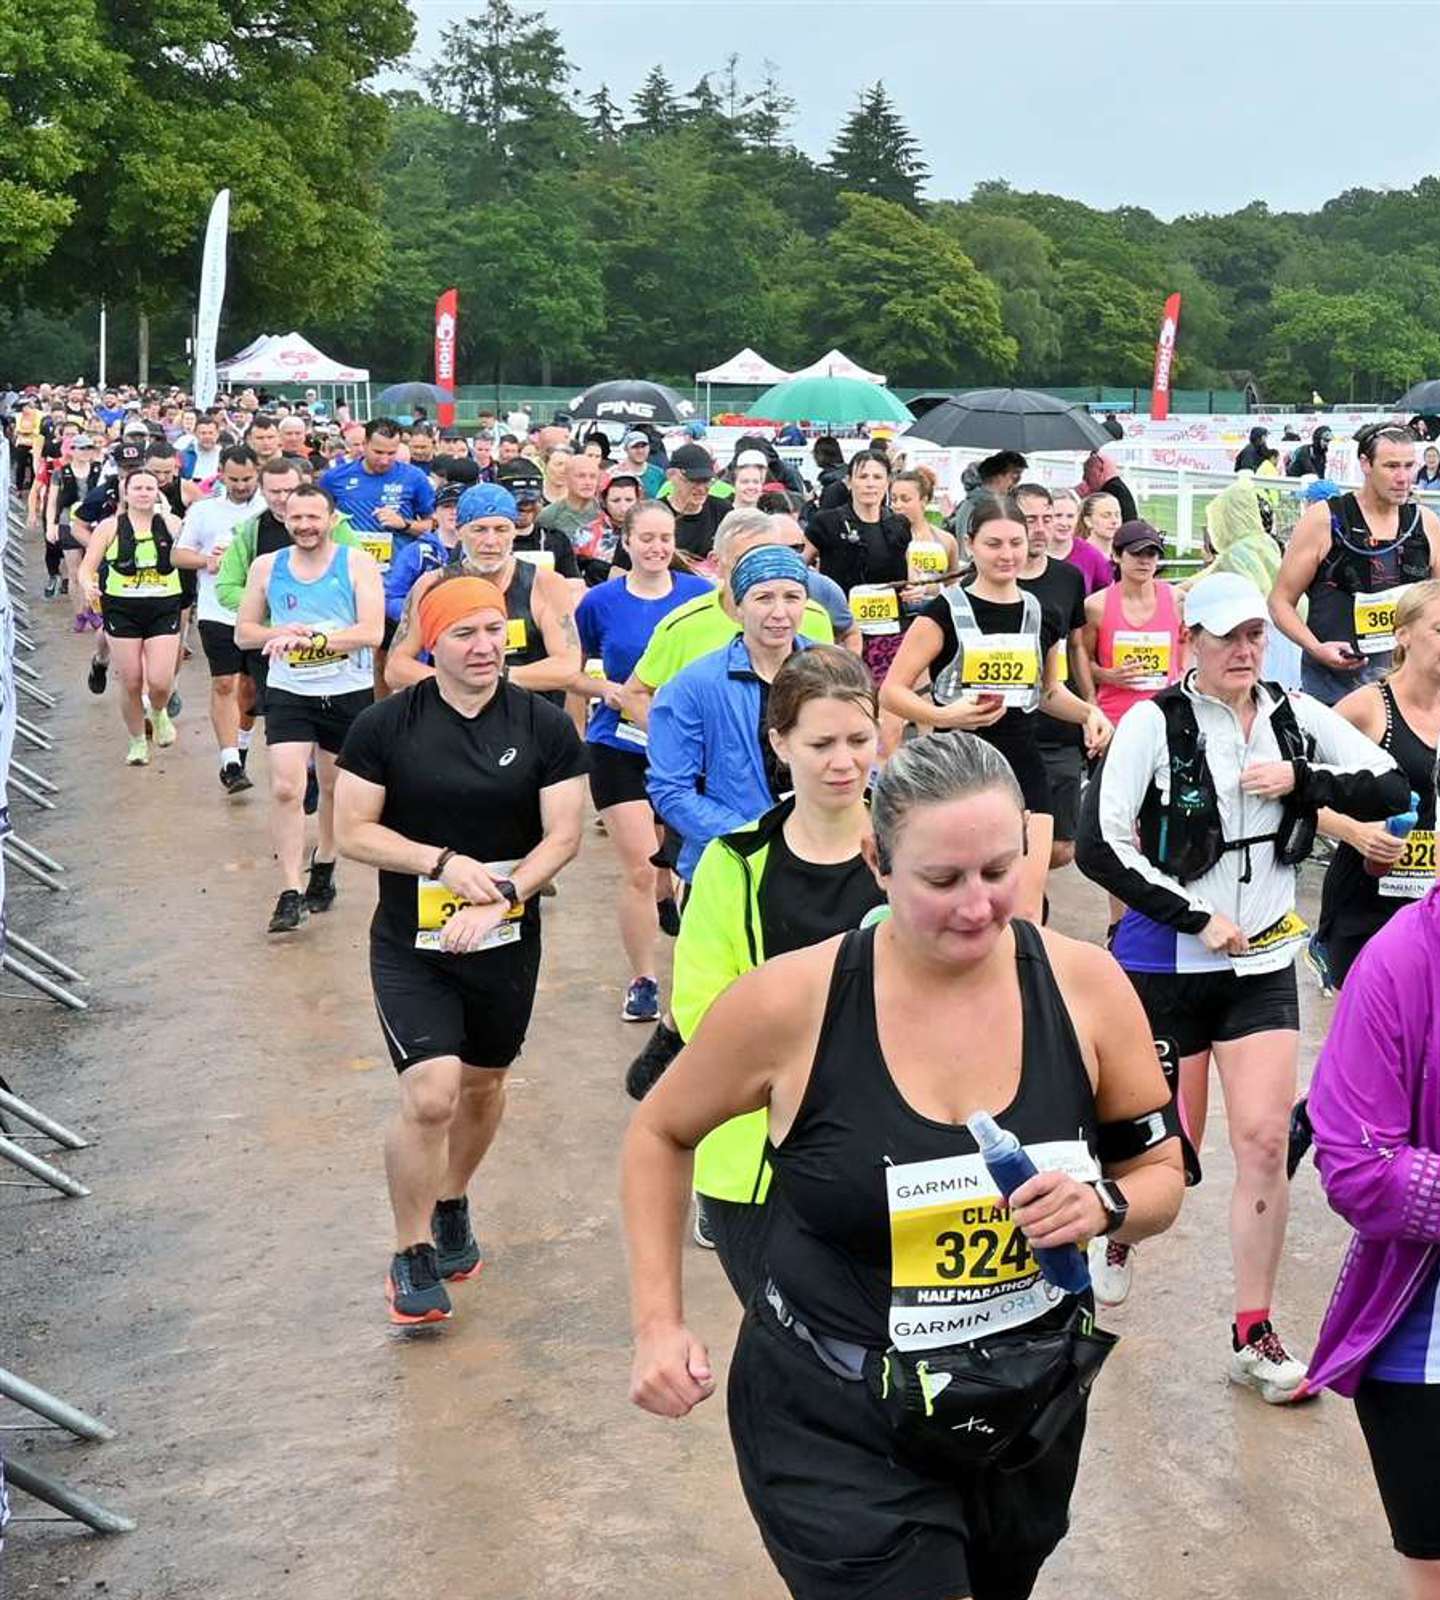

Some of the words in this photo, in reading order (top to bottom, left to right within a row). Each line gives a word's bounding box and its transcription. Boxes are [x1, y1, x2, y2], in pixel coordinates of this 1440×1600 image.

[596, 400, 657, 418] PING
[978, 662, 1024, 681] 3332
[896, 1175, 979, 1199] GARMIN
[962, 1207, 1017, 1225] CLAI
[935, 1229, 1040, 1280] 324
[917, 1289, 956, 1303] HALF
[957, 1274, 1036, 1302] MARATHON
[894, 1311, 991, 1337] GARMIN
